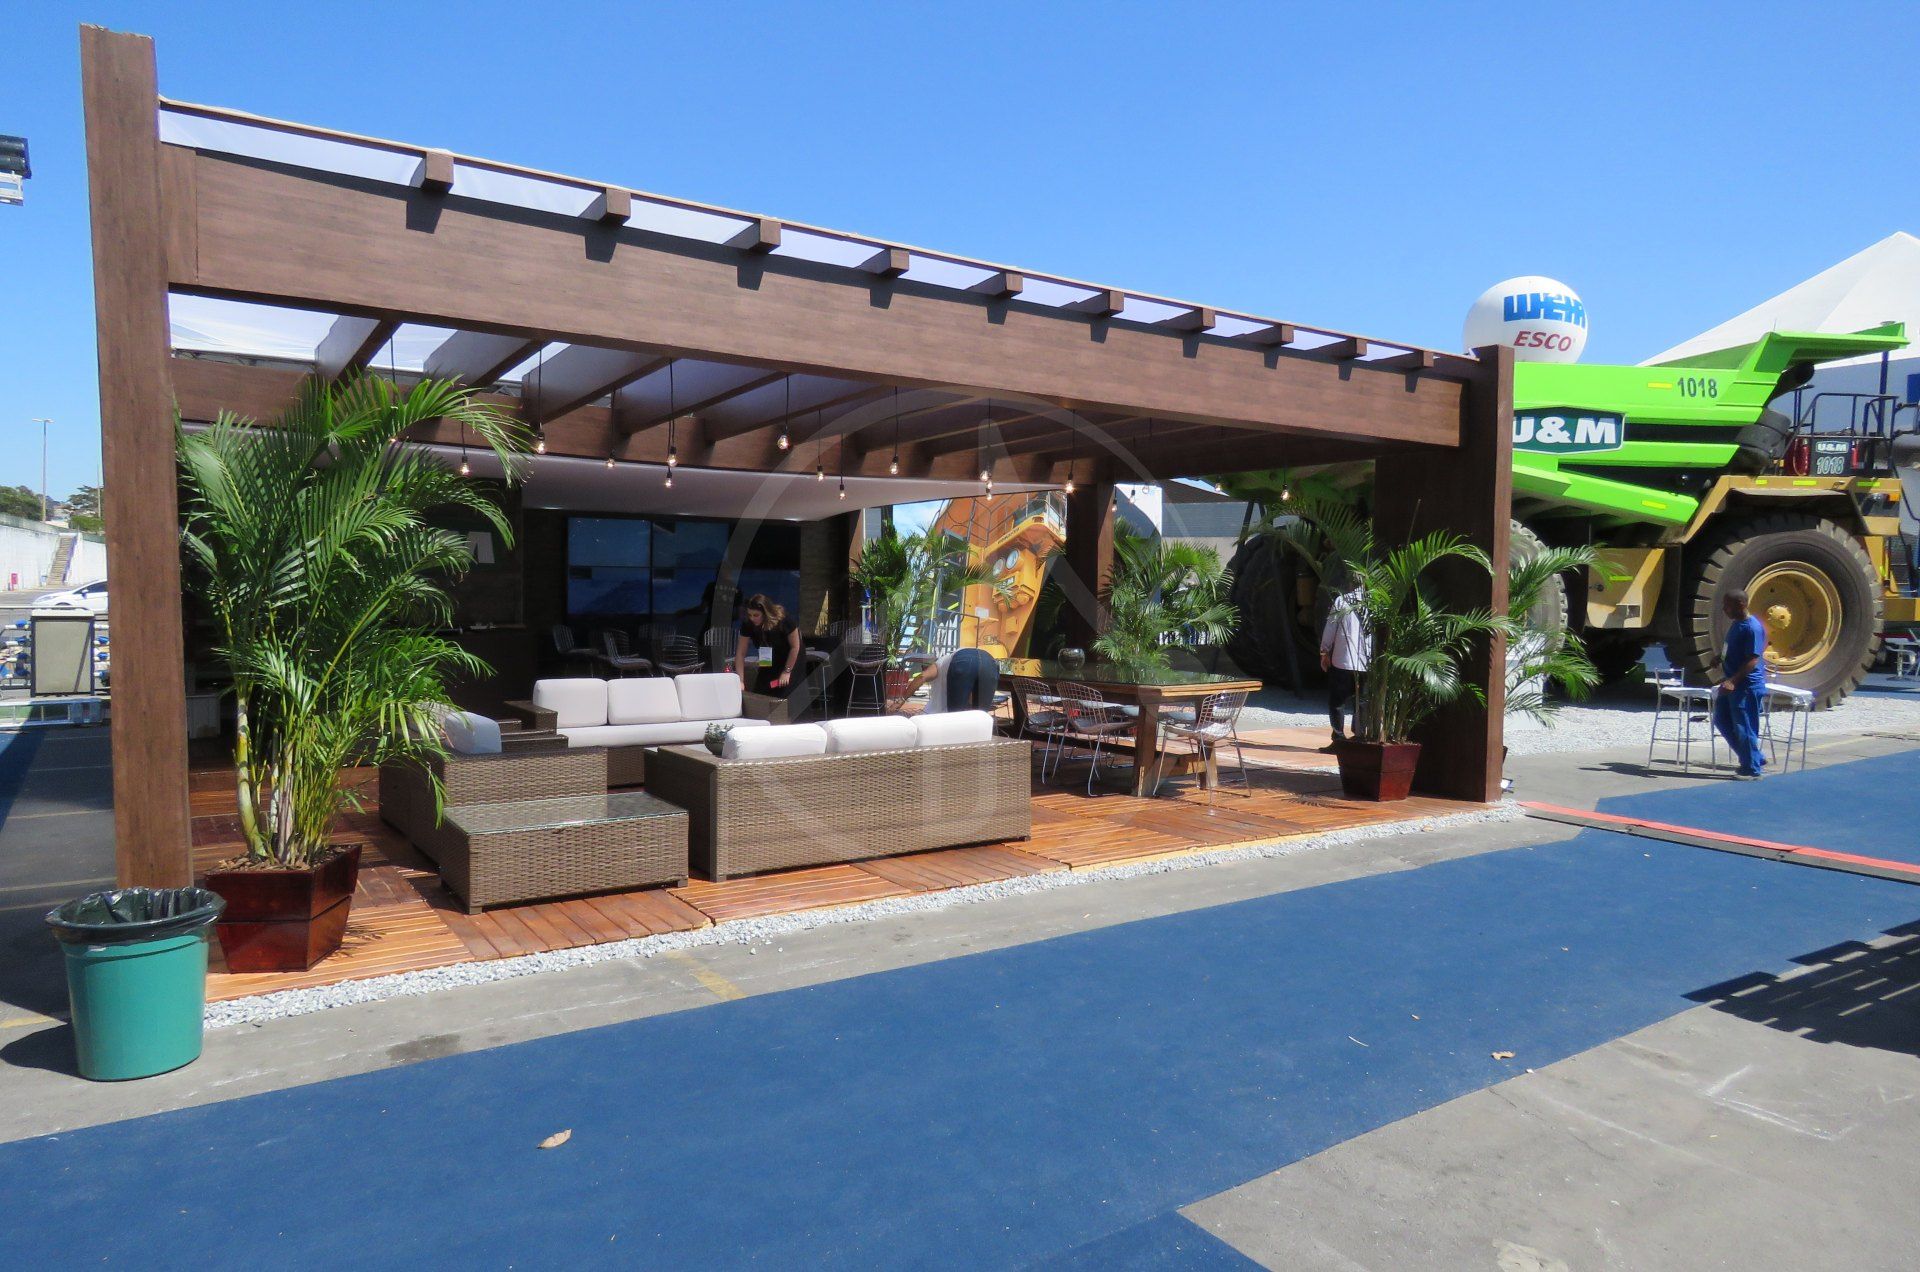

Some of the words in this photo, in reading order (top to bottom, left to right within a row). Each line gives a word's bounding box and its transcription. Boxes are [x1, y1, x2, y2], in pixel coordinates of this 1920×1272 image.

[1513, 330, 1572, 352] ESCO
[1677, 377, 1718, 398] 1018
[1513, 416, 1617, 444] U&M
[1817, 443, 1847, 451] U&M
[1816, 456, 1845, 475] 1018
